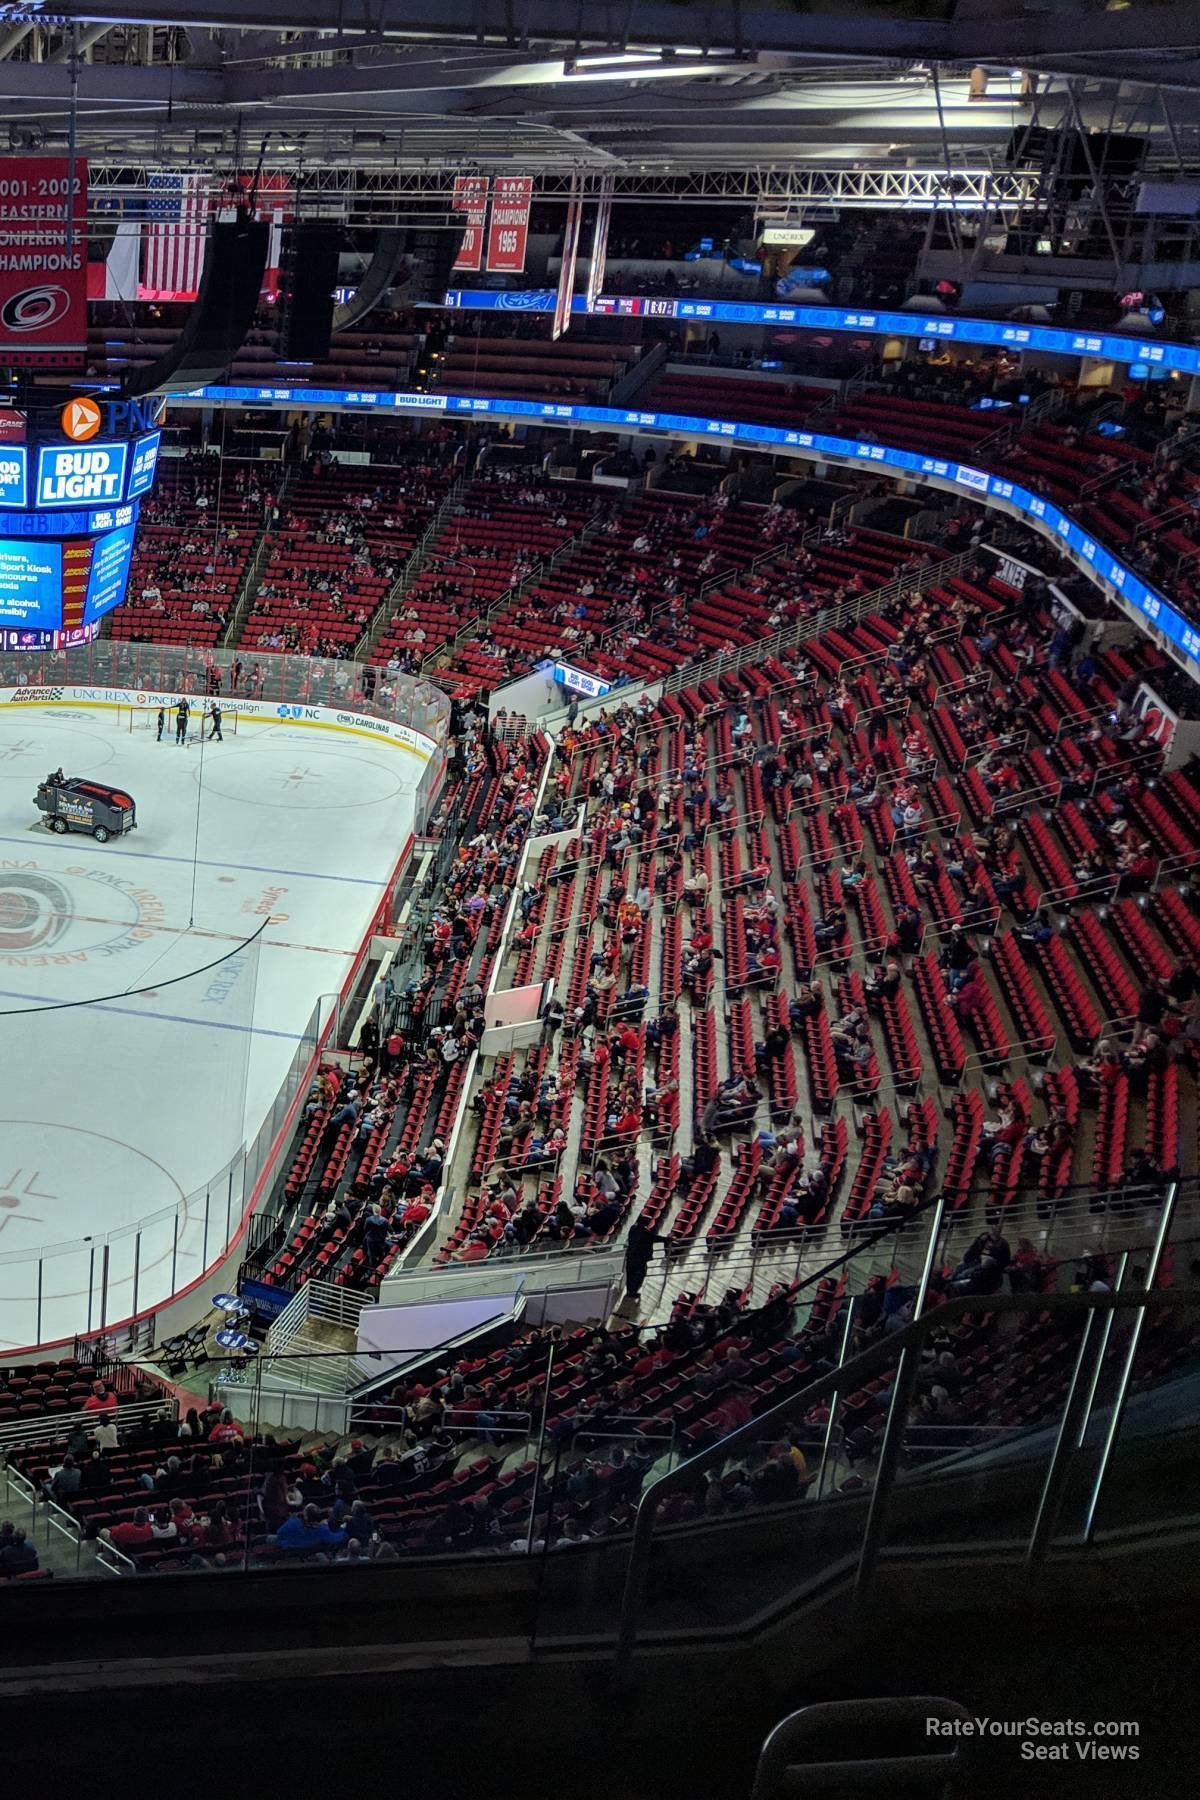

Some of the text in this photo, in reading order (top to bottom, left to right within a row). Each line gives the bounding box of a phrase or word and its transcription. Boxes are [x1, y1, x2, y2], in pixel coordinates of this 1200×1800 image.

[0, 204, 69, 221] EASTERN
[493, 209, 528, 226] CHAMPIONS
[498, 231, 518, 253] 1965
[400, 396, 442, 406] BUD LIGHT
[107, 397, 161, 434] PNC
[0, 420, 25, 428] GAME
[55, 452, 110, 476] BUD
[43, 473, 118, 500] LIGHT
[0, 562, 25, 573] Sport
[27, 563, 52, 574] Kiosk
[7, 597, 41, 609] alcohol,
[10, 632, 18, 645] 0
[10, 693, 51, 702] Auto Parts
[15, 687, 50, 696] Advance
[73, 689, 131, 702] UNC REX
[217, 699, 261, 713] invisalign
[305, 709, 320, 720] NC
[355, 718, 390, 734] CAROLINAS
[86, 869, 167, 924] PNC ARENA
[201, 979, 235, 1005] REX
